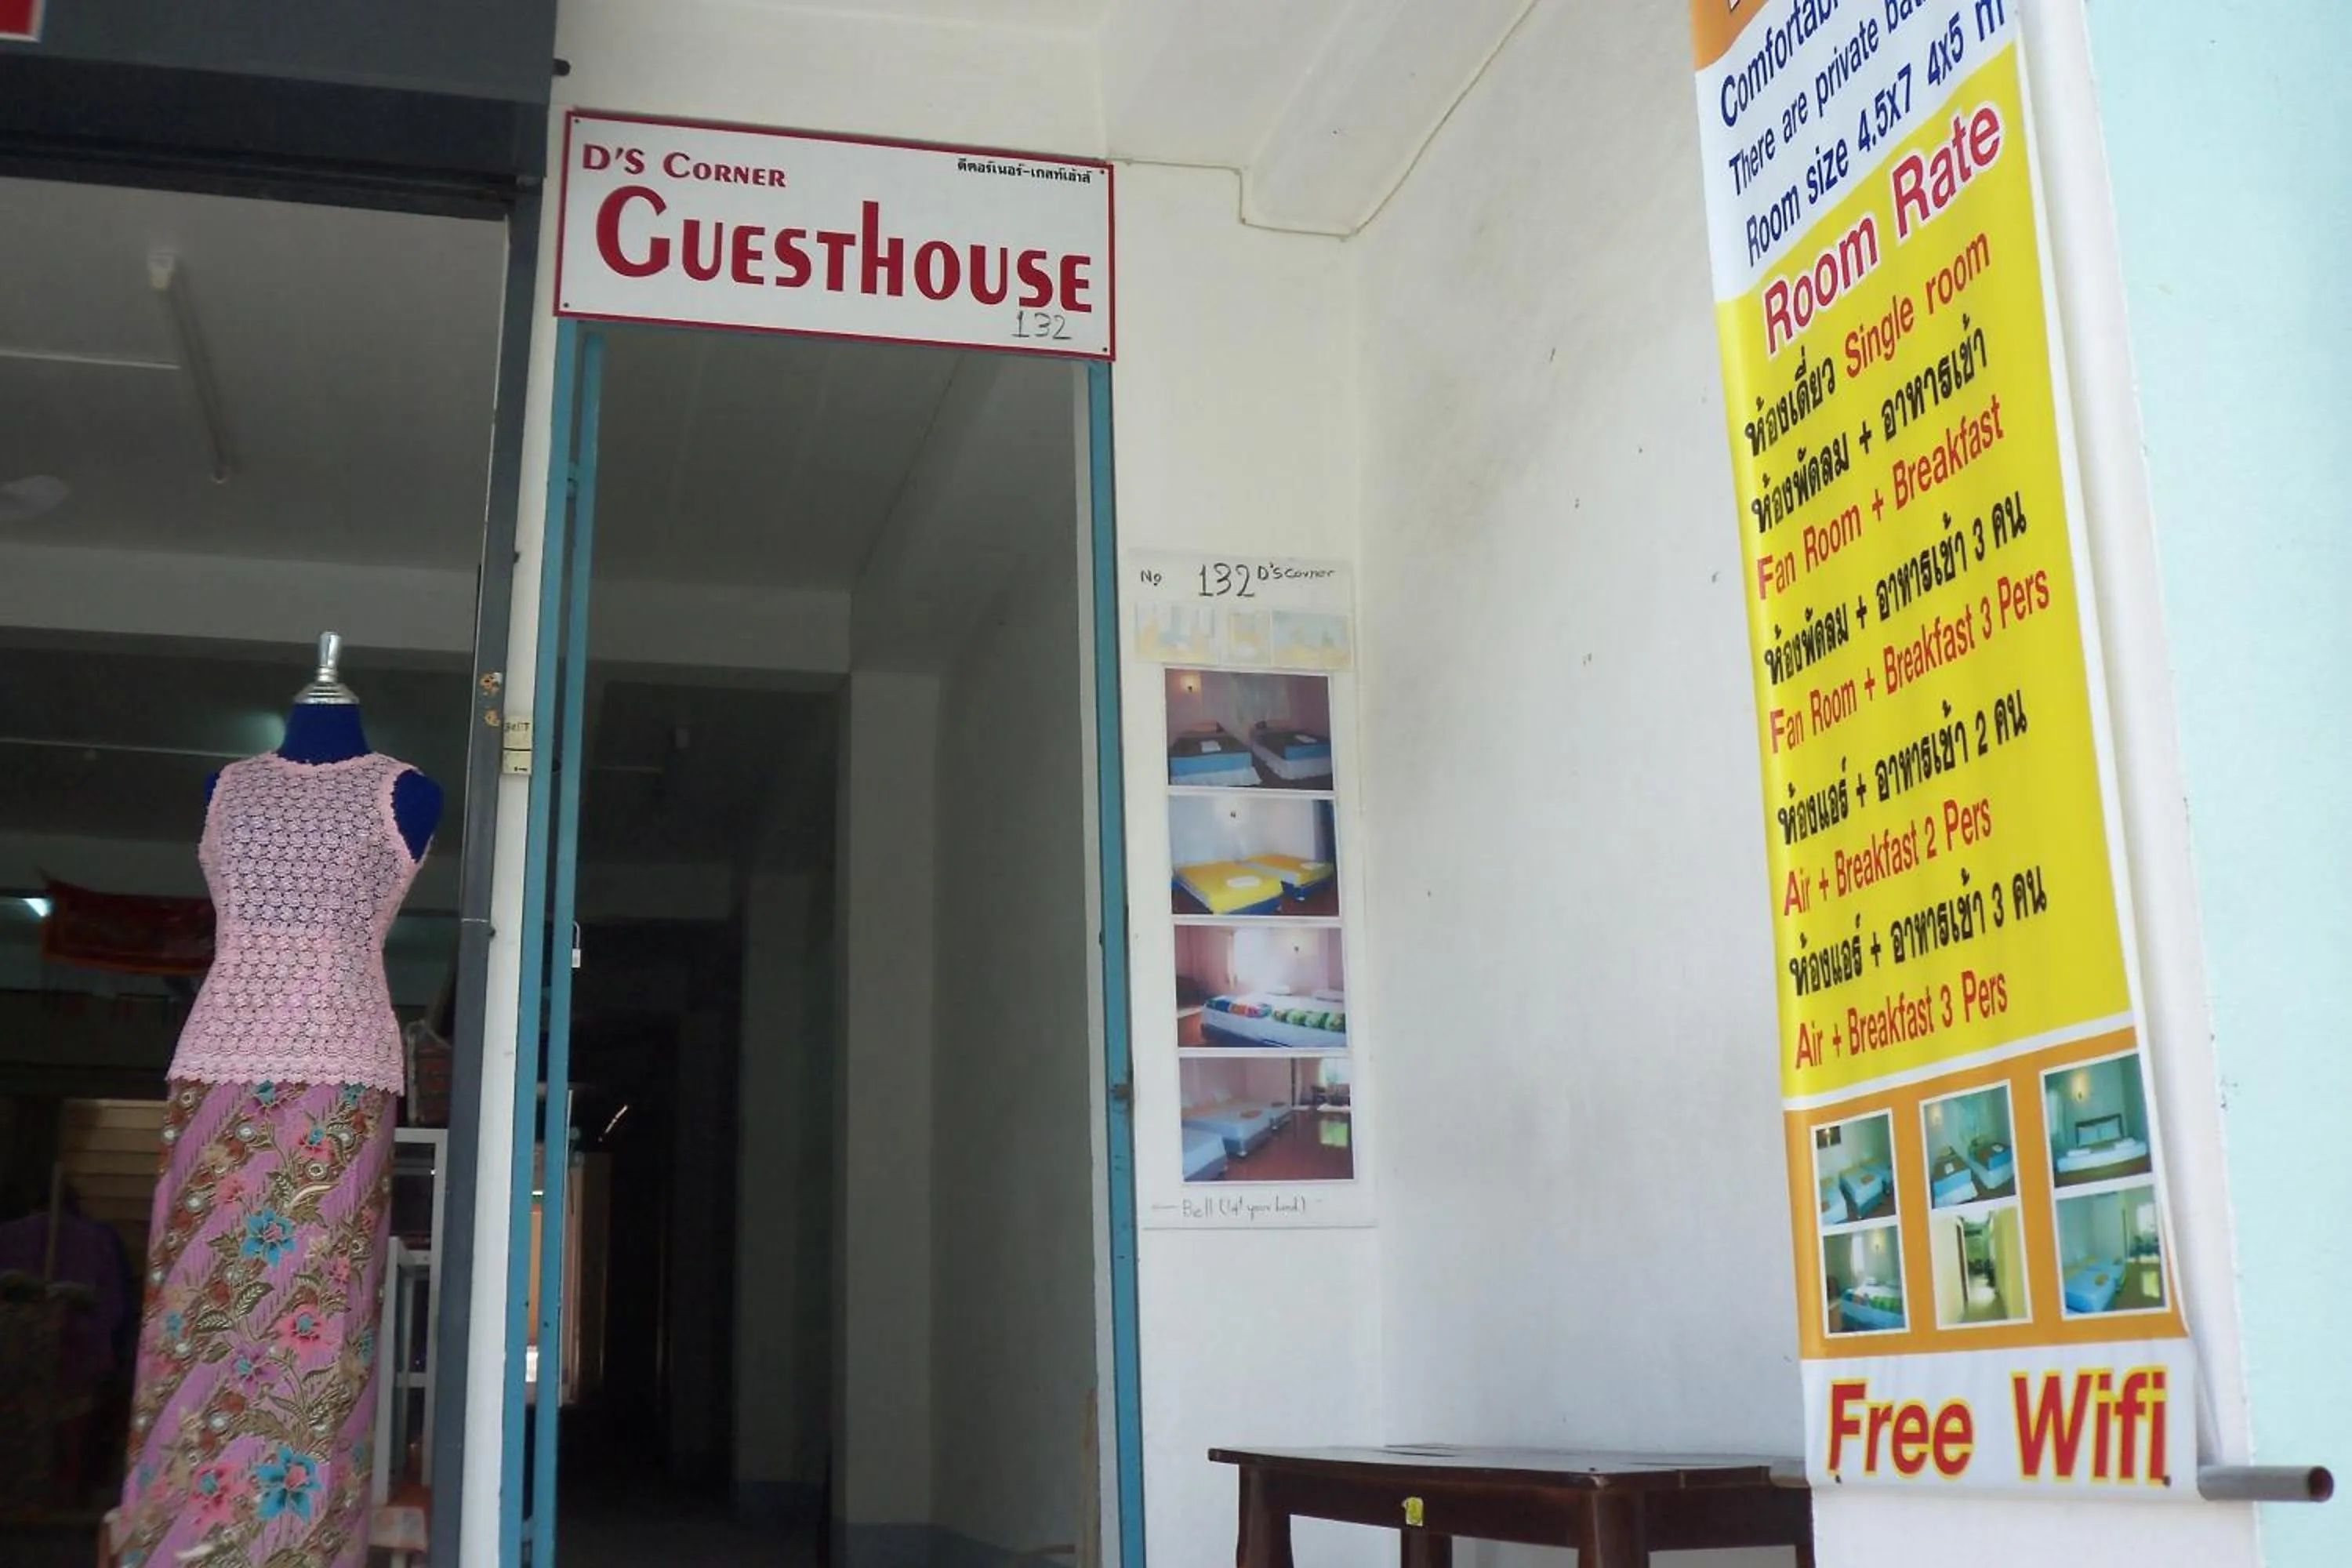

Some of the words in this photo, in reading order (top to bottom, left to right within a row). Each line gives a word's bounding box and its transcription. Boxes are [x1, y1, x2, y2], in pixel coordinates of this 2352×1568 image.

[1720, 0, 1838, 127] Comfortab
[1729, 128, 1775, 196] There
[1782, 93, 1808, 140] are
[1816, 19, 1879, 118] private
[1886, 0, 1926, 34] ba
[582, 143, 645, 176] D'S
[1746, 183, 1801, 267] Room
[1806, 138, 1849, 205] size
[1857, 64, 1912, 154] 4.5x7
[1927, 13, 1964, 86] 4x5
[1764, 216, 1878, 354] Room
[1893, 107, 2001, 238] Rate
[1012, 310, 1073, 339] 132
[1745, 346, 1835, 456] ห้องเดี่ยว
[1844, 295, 1914, 378] Single
[1926, 233, 1990, 314] room
[1751, 433, 1849, 533] ห้องพัดลม
[1859, 421, 1872, 455] +
[1882, 314, 1987, 441] อาหารเช้า
[1757, 548, 1796, 600] Fan
[1803, 505, 1862, 573] Room
[1871, 489, 1884, 522] +
[1893, 394, 2004, 510] Breakfast
[1199, 563, 1254, 597] 132
[1764, 602, 1849, 685] ห้องพัดลม
[1856, 596, 1867, 629] +
[1876, 512, 1967, 621] อาหารเช้า
[1973, 517, 1984, 562] 3
[1991, 491, 2027, 549] คน
[1769, 709, 1804, 754] Fan
[1809, 679, 1857, 736] Room
[1864, 668, 1875, 701] +
[1883, 604, 1976, 695] Breakfast
[1980, 597, 1992, 640] 3
[1997, 570, 2050, 628] Pers
[1856, 773, 1867, 808] +
[1875, 699, 1969, 802] อาหารเช้า
[1975, 710, 1987, 757] 2
[1994, 689, 2027, 745] คน
[1784, 868, 1810, 916] Air
[1819, 869, 1829, 902] +
[1835, 819, 1919, 898] Breakfast
[1925, 817, 1936, 861] 2
[1944, 798, 1992, 851] Pers
[1871, 931, 1881, 967] +
[1891, 868, 1985, 964] อาหารเช้า
[1992, 883, 2004, 927] 3
[2013, 866, 2047, 920] คน
[1795, 1023, 1823, 1069] Air
[1832, 1027, 1842, 1058] +
[1847, 986, 1934, 1055] Breakfast
[1940, 985, 1953, 1029] 3
[1962, 970, 2008, 1022] Pers
[1182, 1197, 1214, 1218] Bell
[1828, 1379, 1974, 1478] Free
[2010, 1365, 2168, 1486] Wifi
